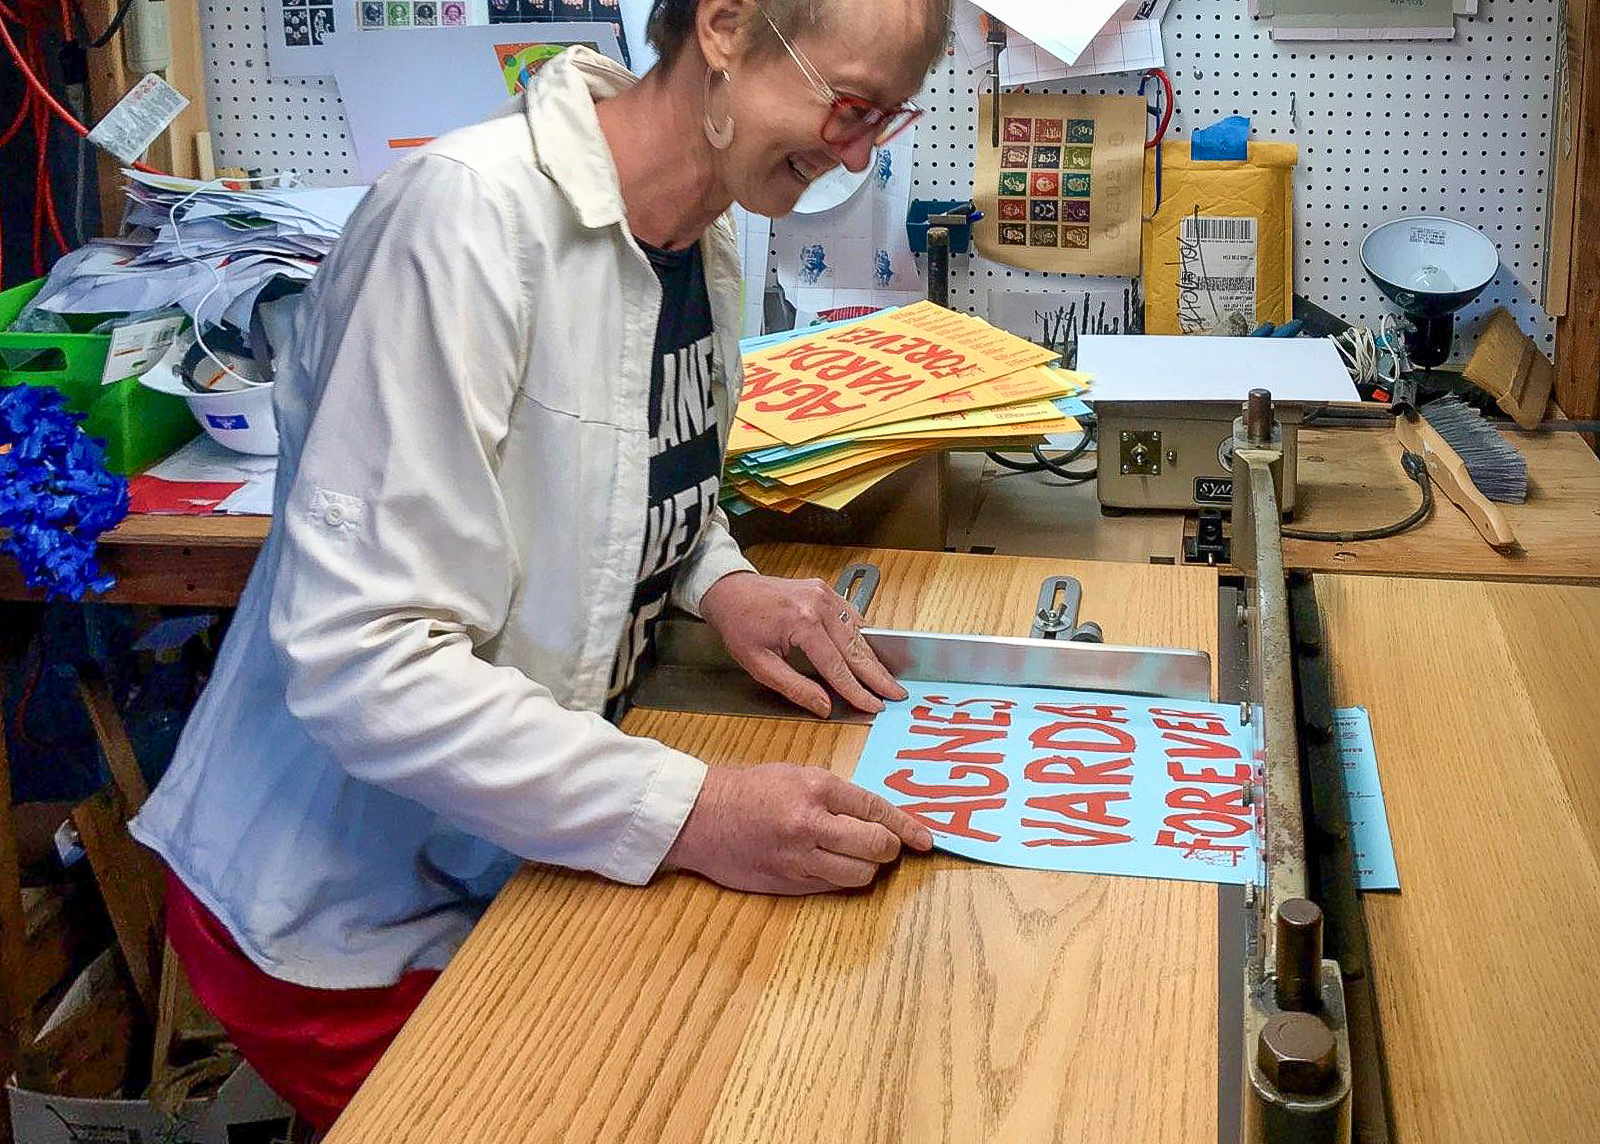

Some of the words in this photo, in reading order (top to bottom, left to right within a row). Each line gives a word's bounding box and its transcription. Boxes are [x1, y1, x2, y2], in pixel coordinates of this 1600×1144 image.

[767, 342, 926, 402] VARDA
[826, 326, 978, 379] FOREVER
[884, 694, 1018, 842] AGNES
[1020, 703, 1137, 848] VARDA
[1148, 707, 1253, 850] FOREVER
